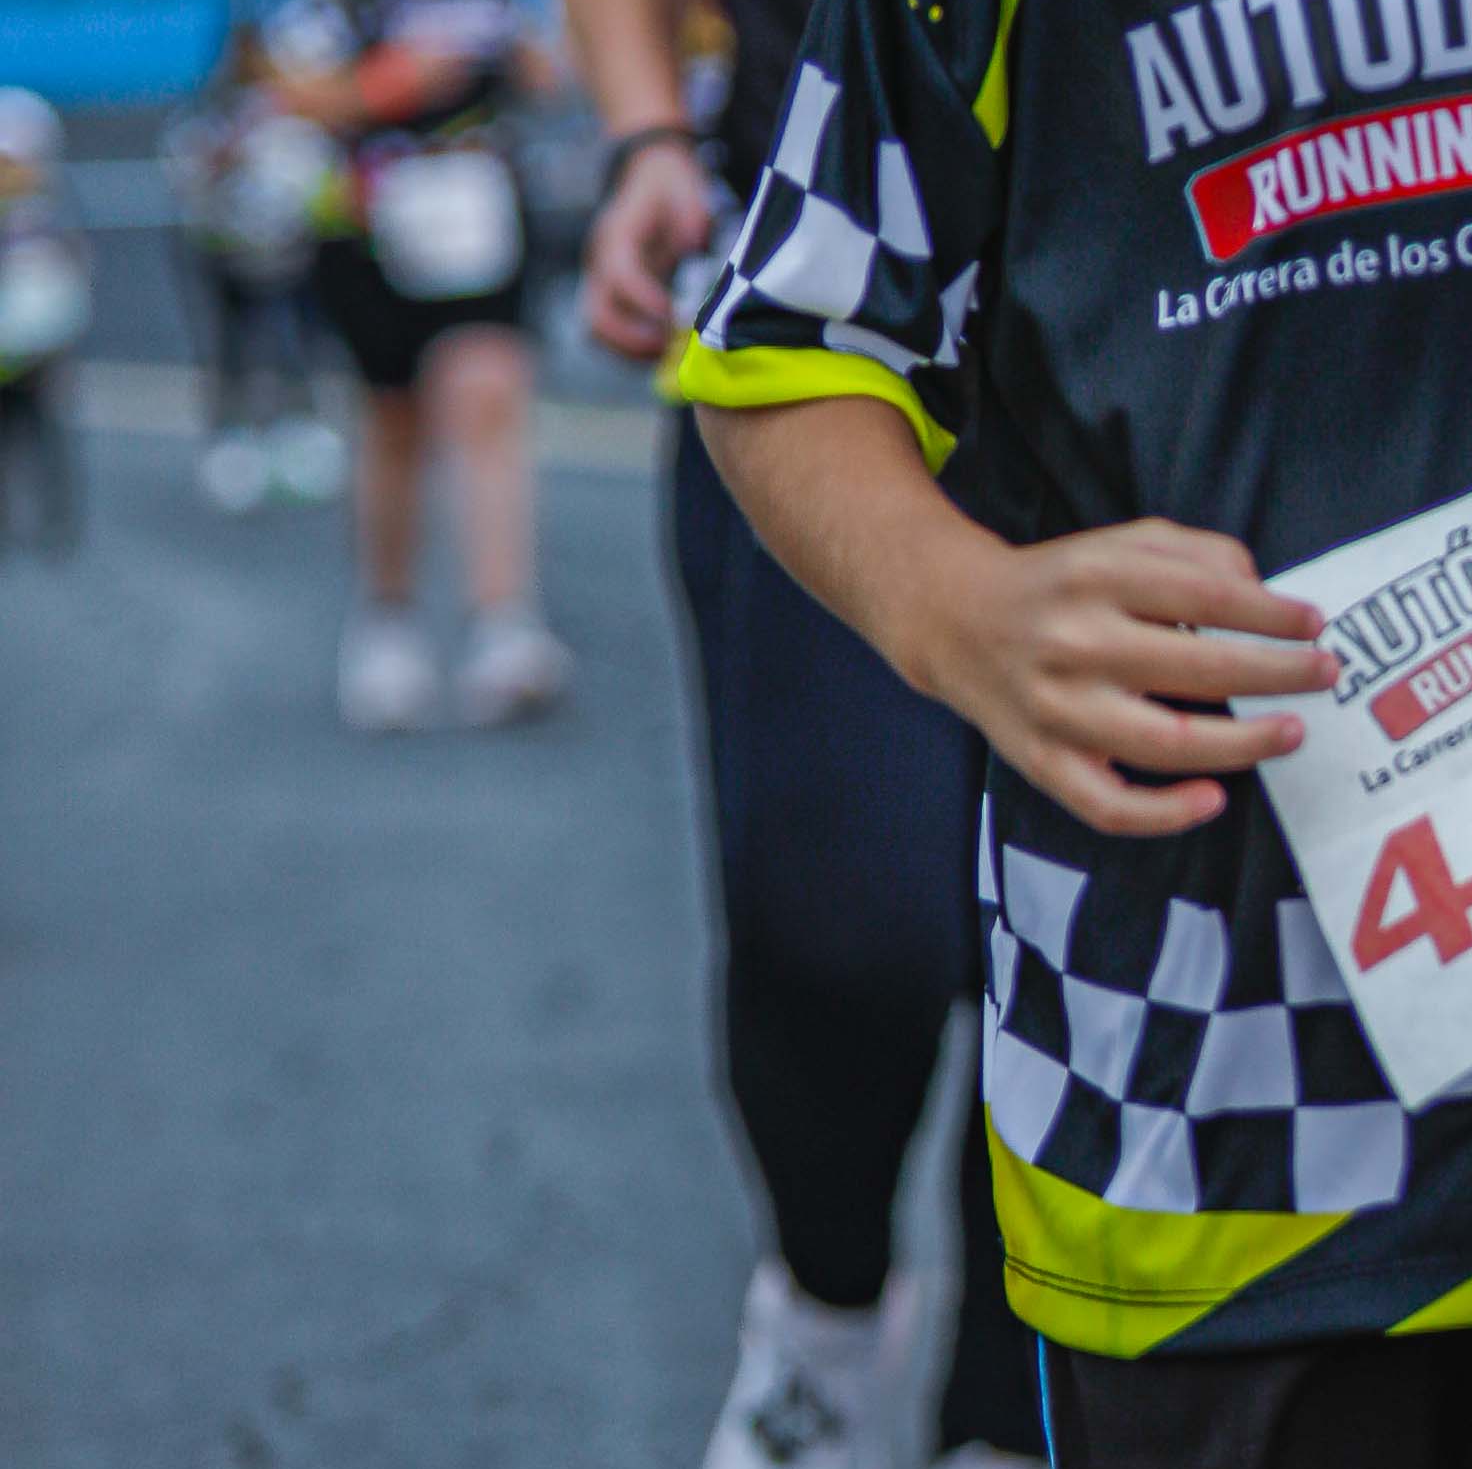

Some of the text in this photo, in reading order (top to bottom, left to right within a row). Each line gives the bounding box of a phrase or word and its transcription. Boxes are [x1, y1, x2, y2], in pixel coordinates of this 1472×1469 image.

[1157, 288, 1200, 329] La
[1204, 255, 1318, 319] Crrera
[1327, 237, 1380, 283] de
[1386, 232, 1449, 277] los
[1358, 766, 1392, 793] La
